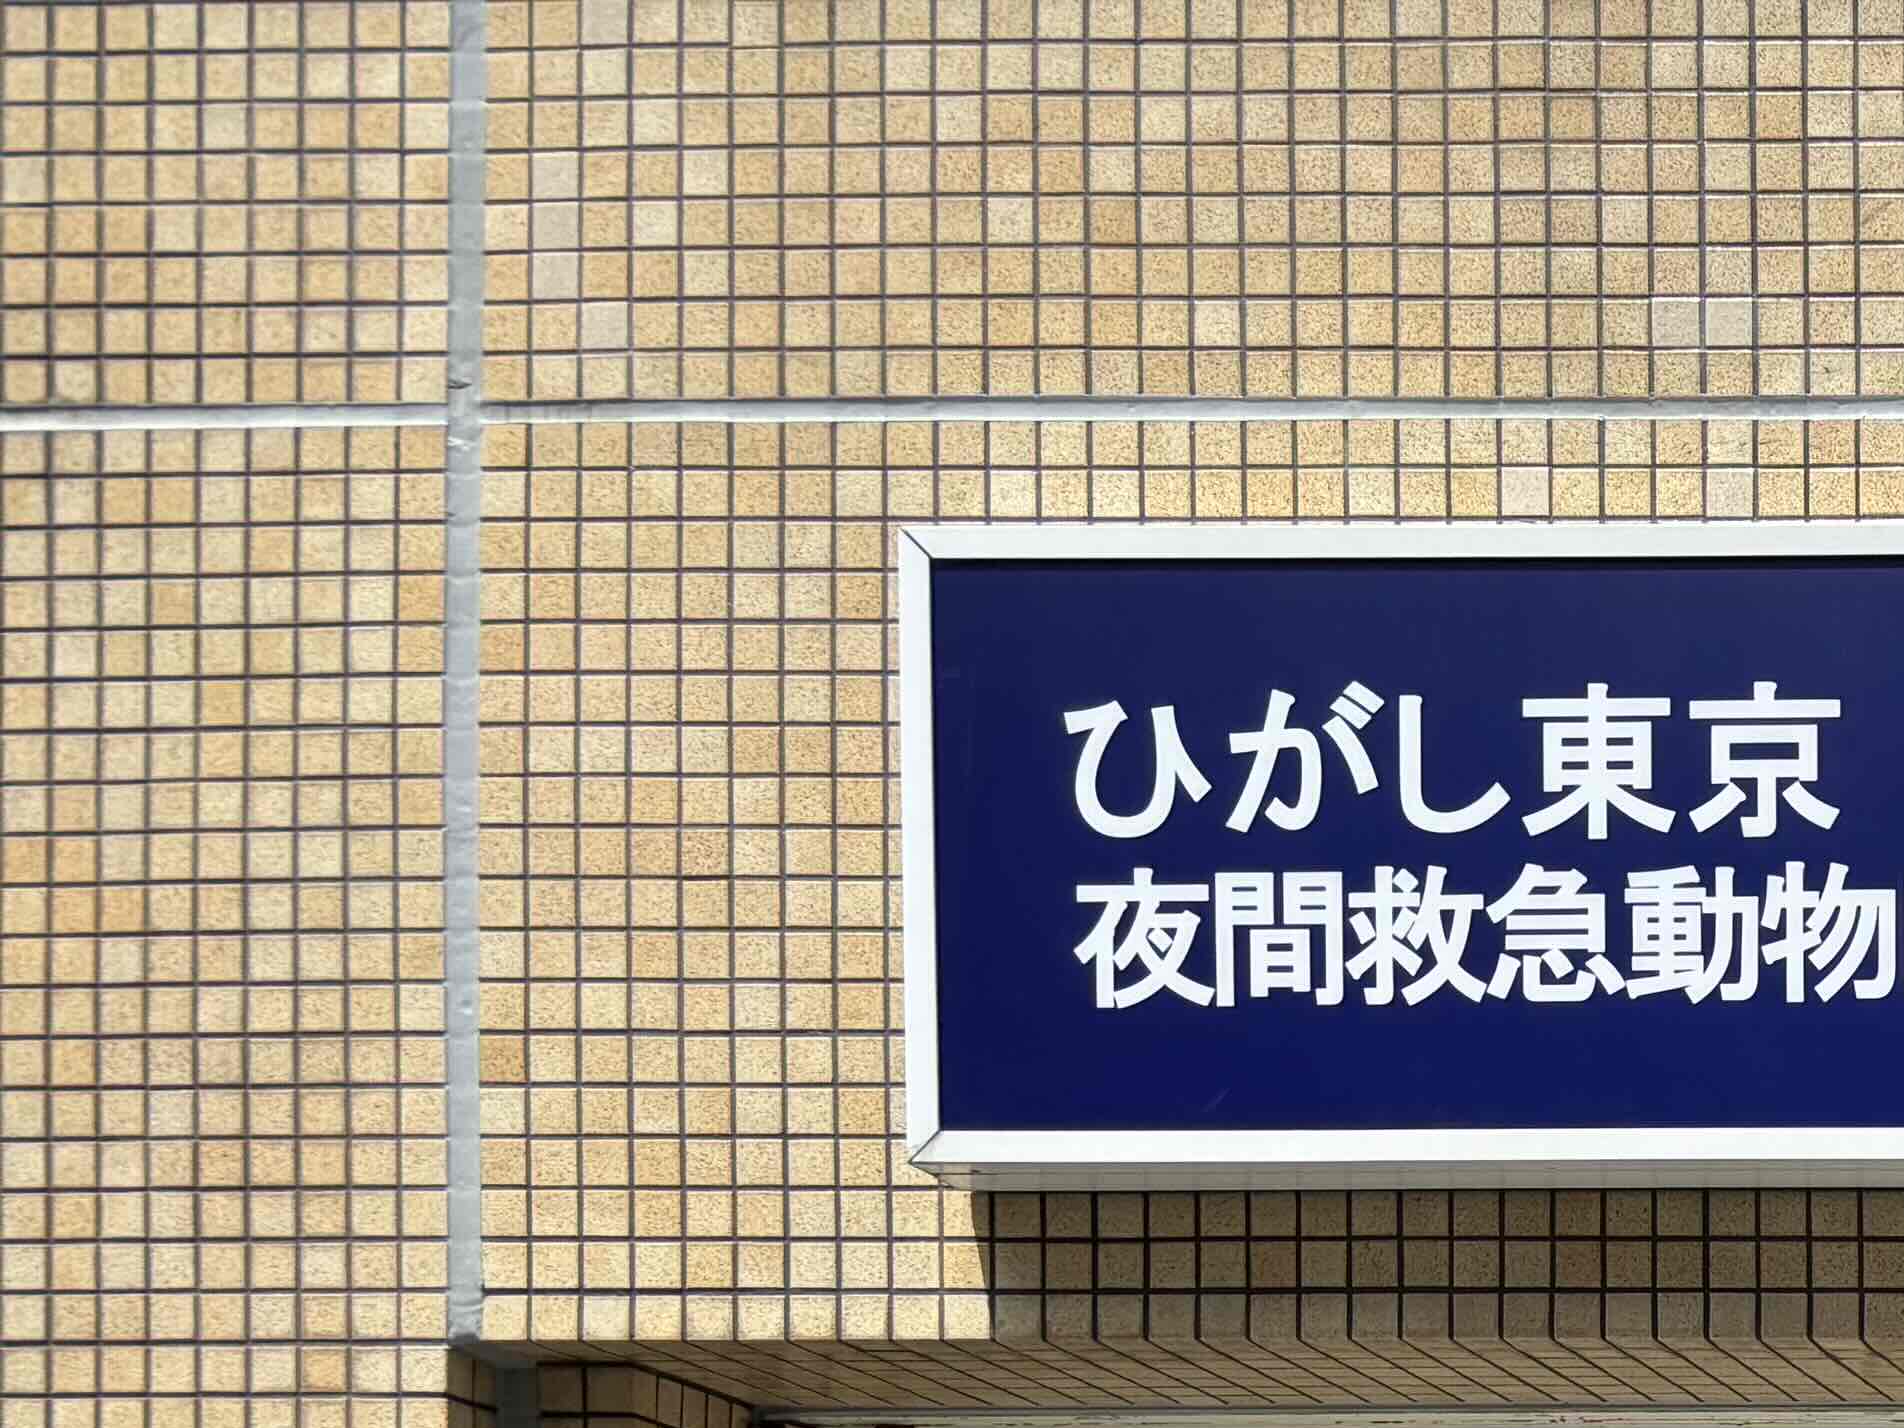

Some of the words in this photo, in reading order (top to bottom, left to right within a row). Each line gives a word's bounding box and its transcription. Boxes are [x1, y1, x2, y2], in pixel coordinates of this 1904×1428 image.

[1064, 679, 1844, 842] ひがし東京
